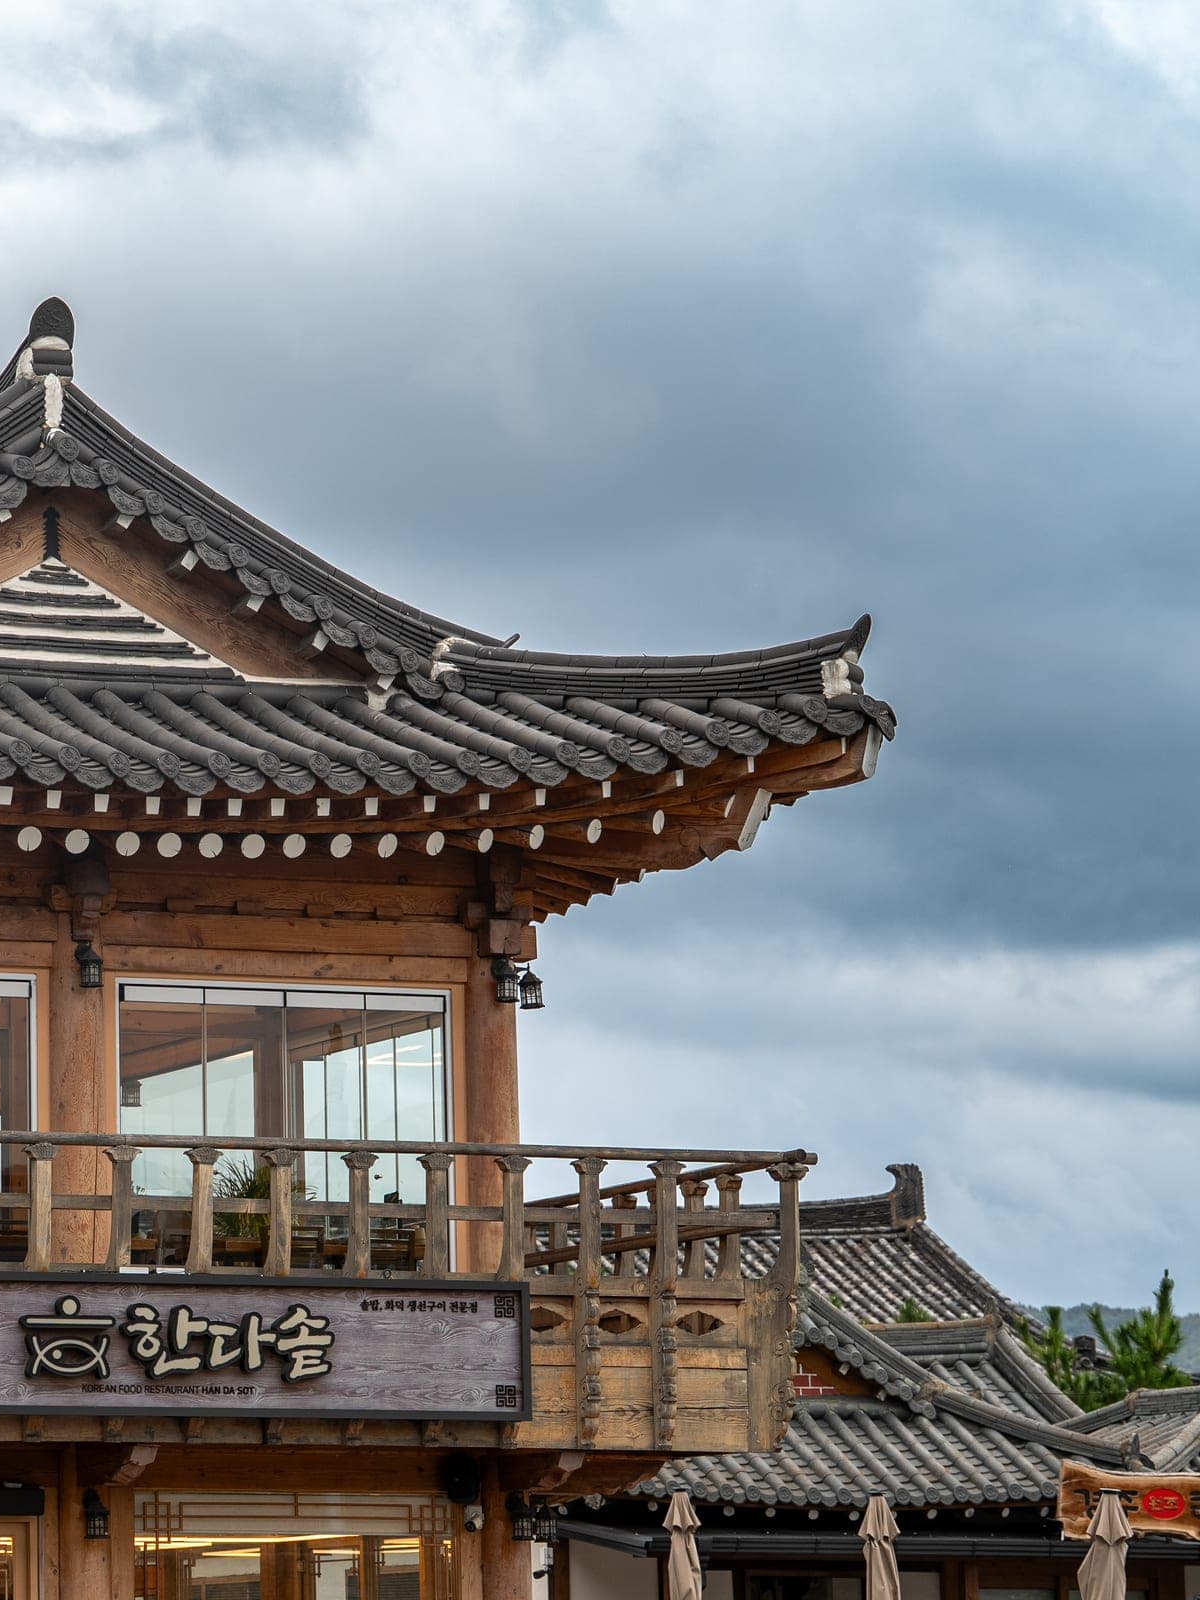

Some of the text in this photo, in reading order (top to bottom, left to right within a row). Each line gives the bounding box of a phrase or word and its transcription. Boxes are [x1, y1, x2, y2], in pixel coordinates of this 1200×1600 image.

[385, 1300, 404, 1312] 화덕
[407, 1300, 446, 1312] 생선구이
[449, 1301, 478, 1313] 전문점
[122, 1304, 334, 1382] 한다솥
[81, 1383, 255, 1395] KOREAN FOOD RESTAURANT HAN DA SOT
